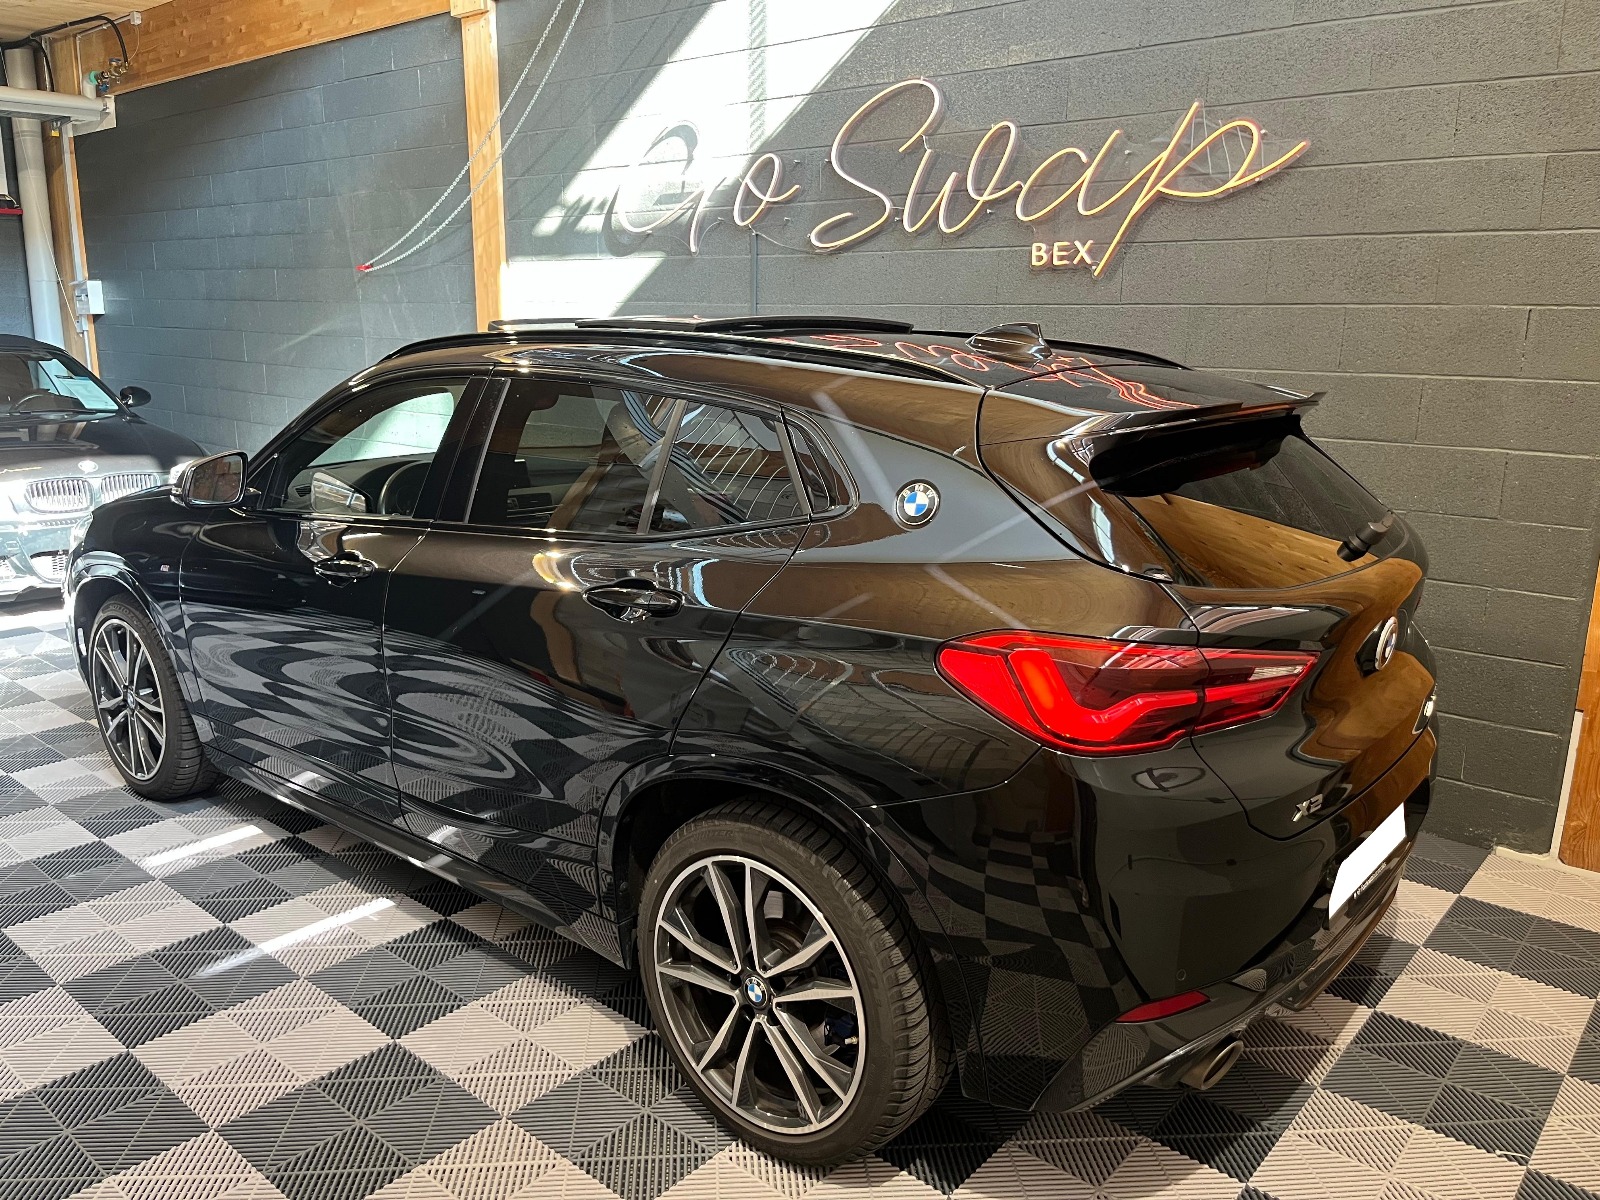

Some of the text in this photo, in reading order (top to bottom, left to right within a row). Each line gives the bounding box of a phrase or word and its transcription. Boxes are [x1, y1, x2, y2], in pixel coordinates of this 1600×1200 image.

[808, 78, 1308, 277] Swap
[1031, 240, 1094, 266] BEX
[902, 484, 935, 498] BMW
[1291, 793, 1323, 822] X2
